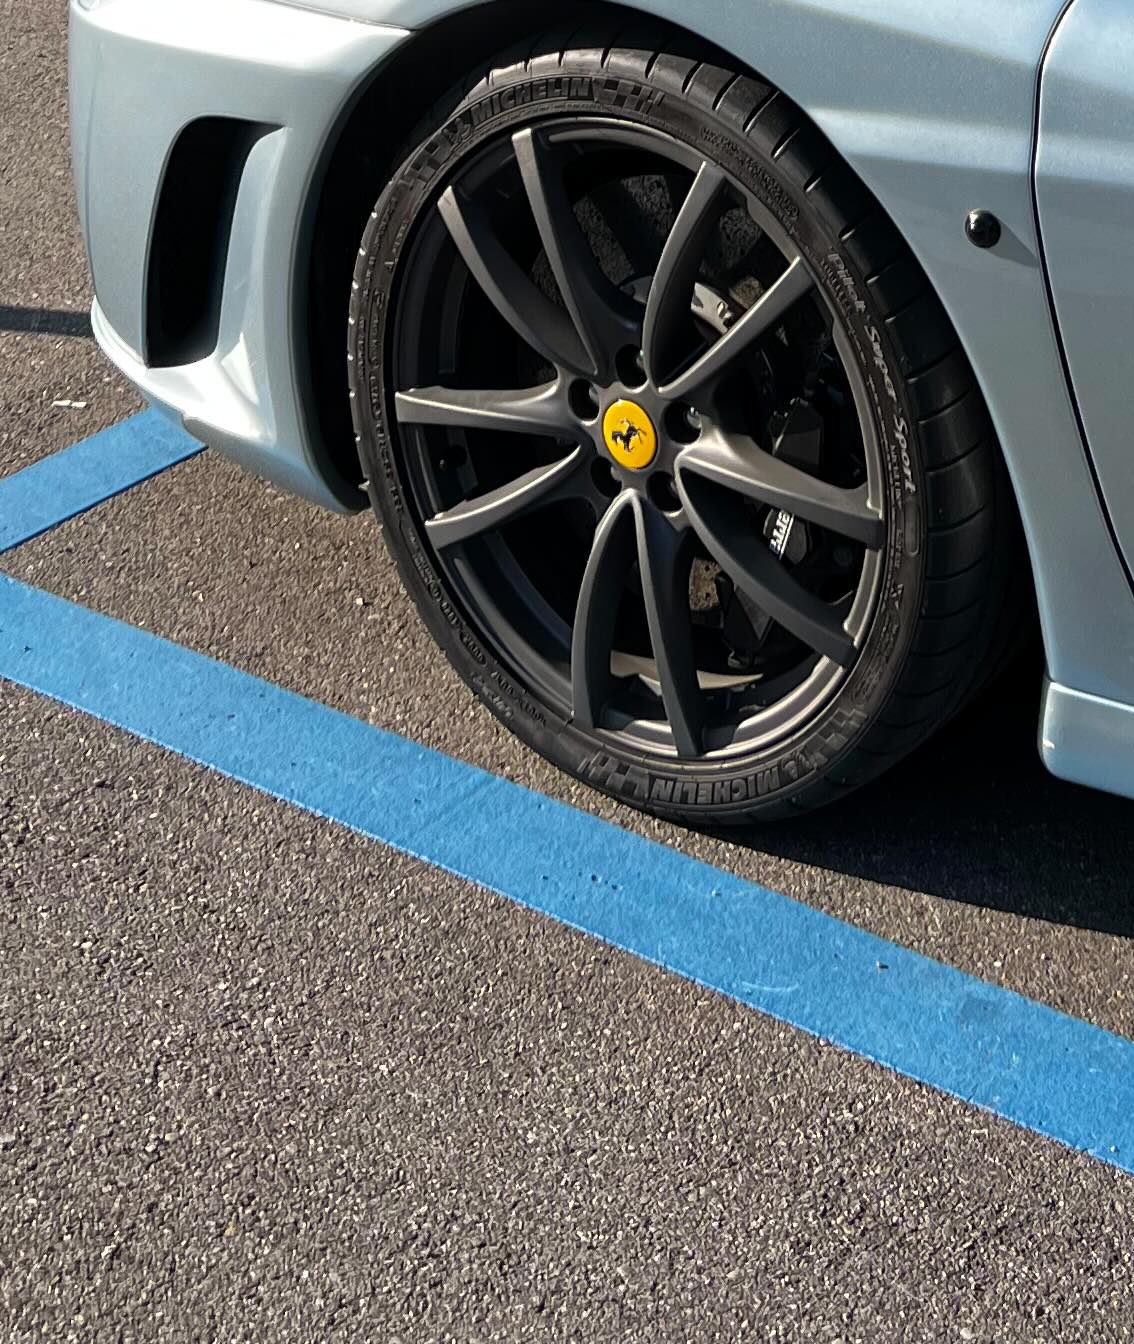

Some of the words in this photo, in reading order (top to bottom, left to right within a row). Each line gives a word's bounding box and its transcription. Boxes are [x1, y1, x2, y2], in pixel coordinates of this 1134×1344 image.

[470, 77, 598, 125] MICHELIN
[827, 252, 866, 313] Pilot
[865, 324, 897, 402] Super
[895, 416, 917, 494] Sport
[651, 765, 782, 804] MICHELIN
